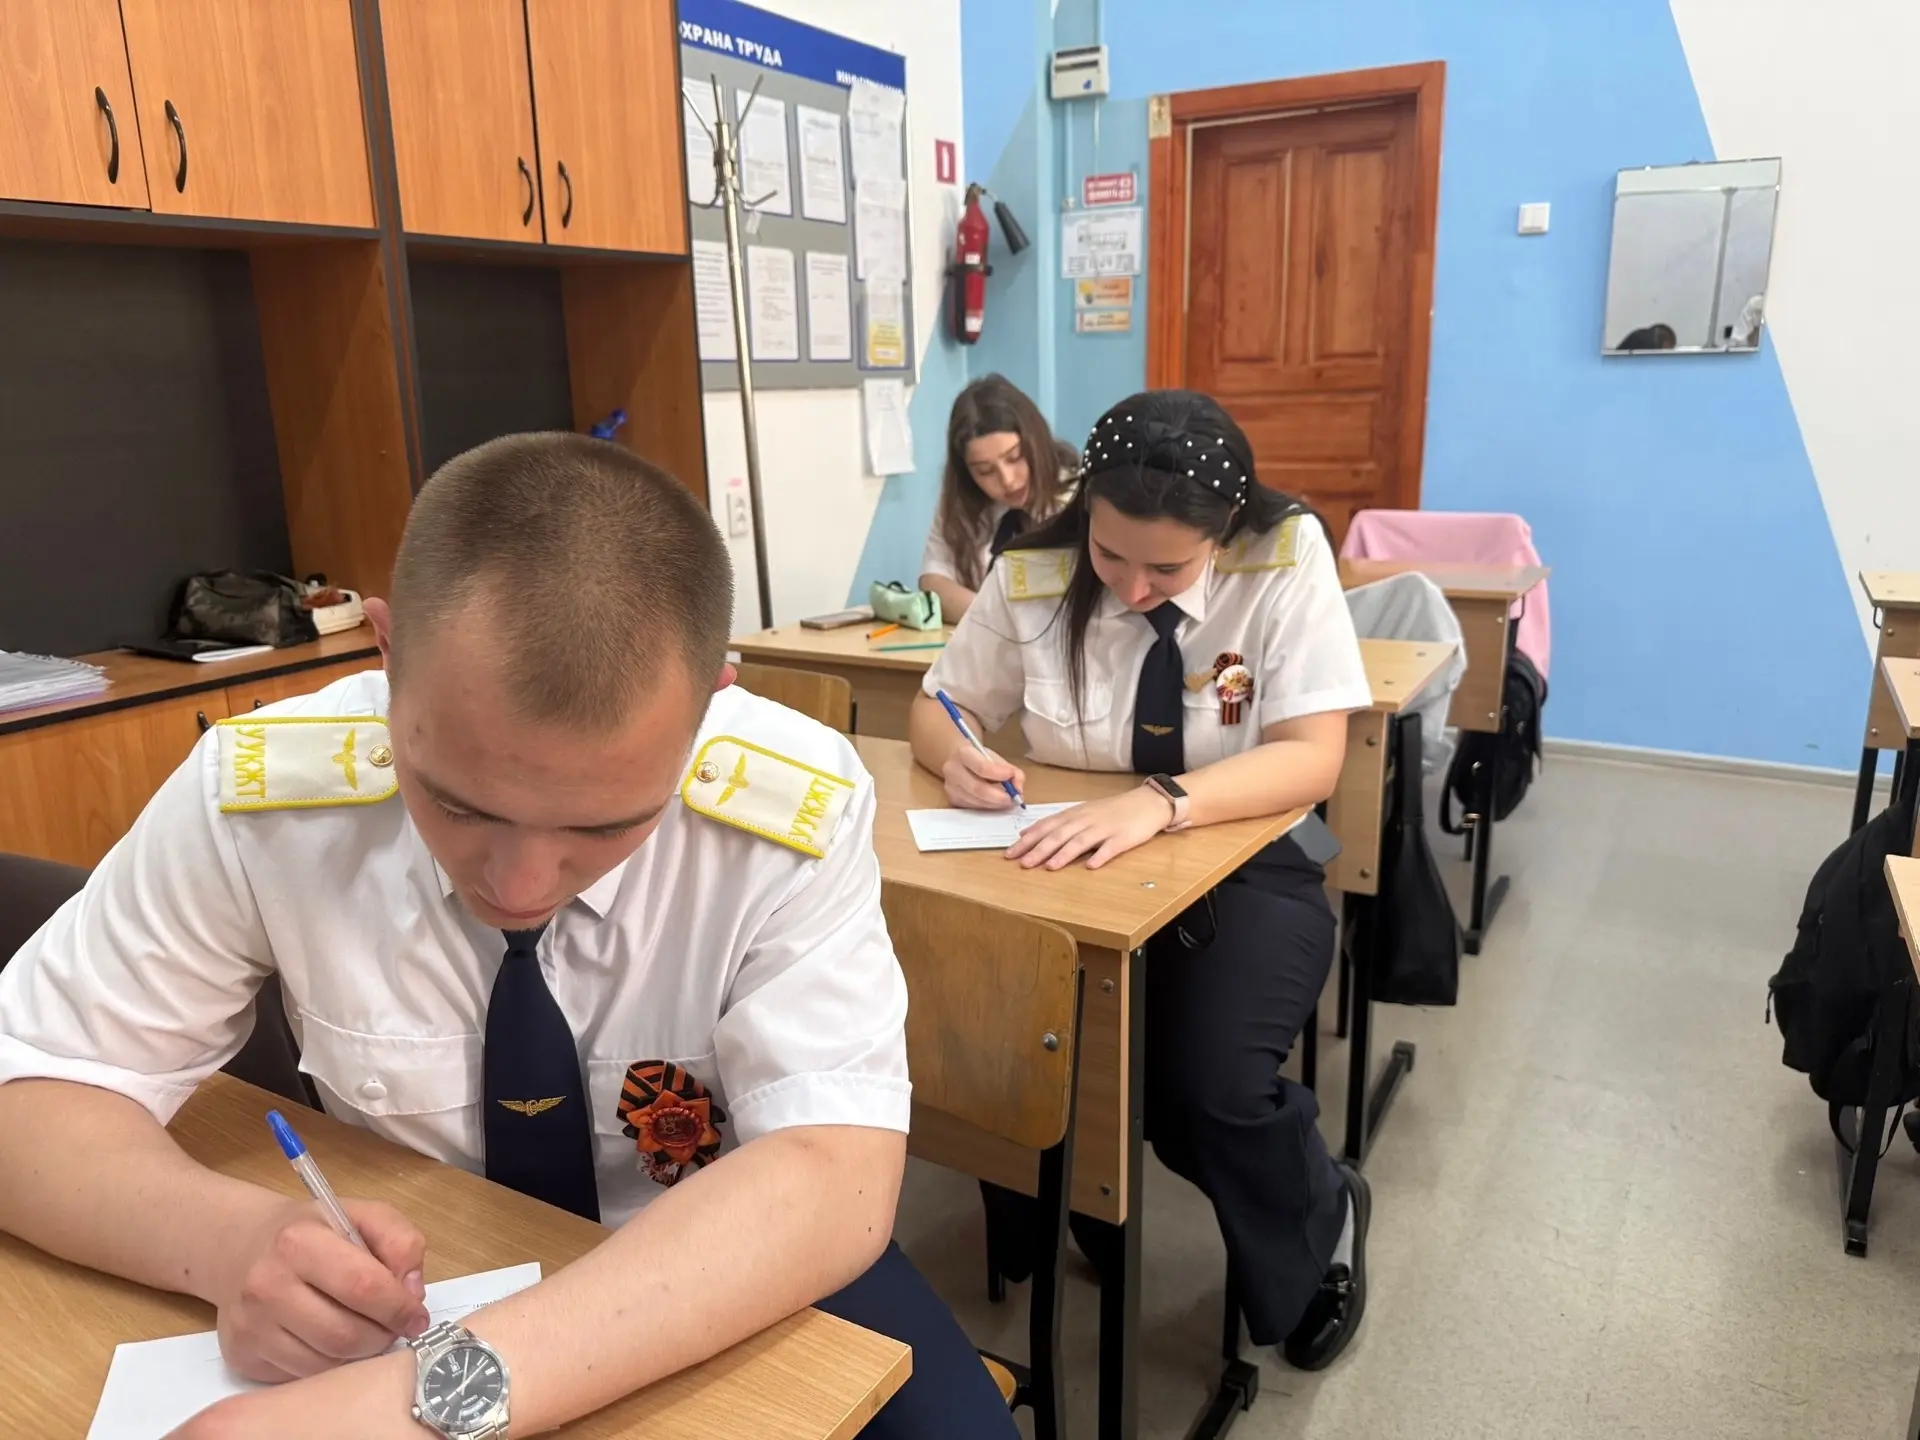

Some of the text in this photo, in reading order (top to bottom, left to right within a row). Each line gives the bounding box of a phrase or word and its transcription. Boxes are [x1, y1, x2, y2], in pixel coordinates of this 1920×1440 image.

[679, 21, 783, 67] ХРАНА ТРУДА
[235, 727, 267, 798] УУКЖТ
[788, 776, 837, 843] УУКЖТ
